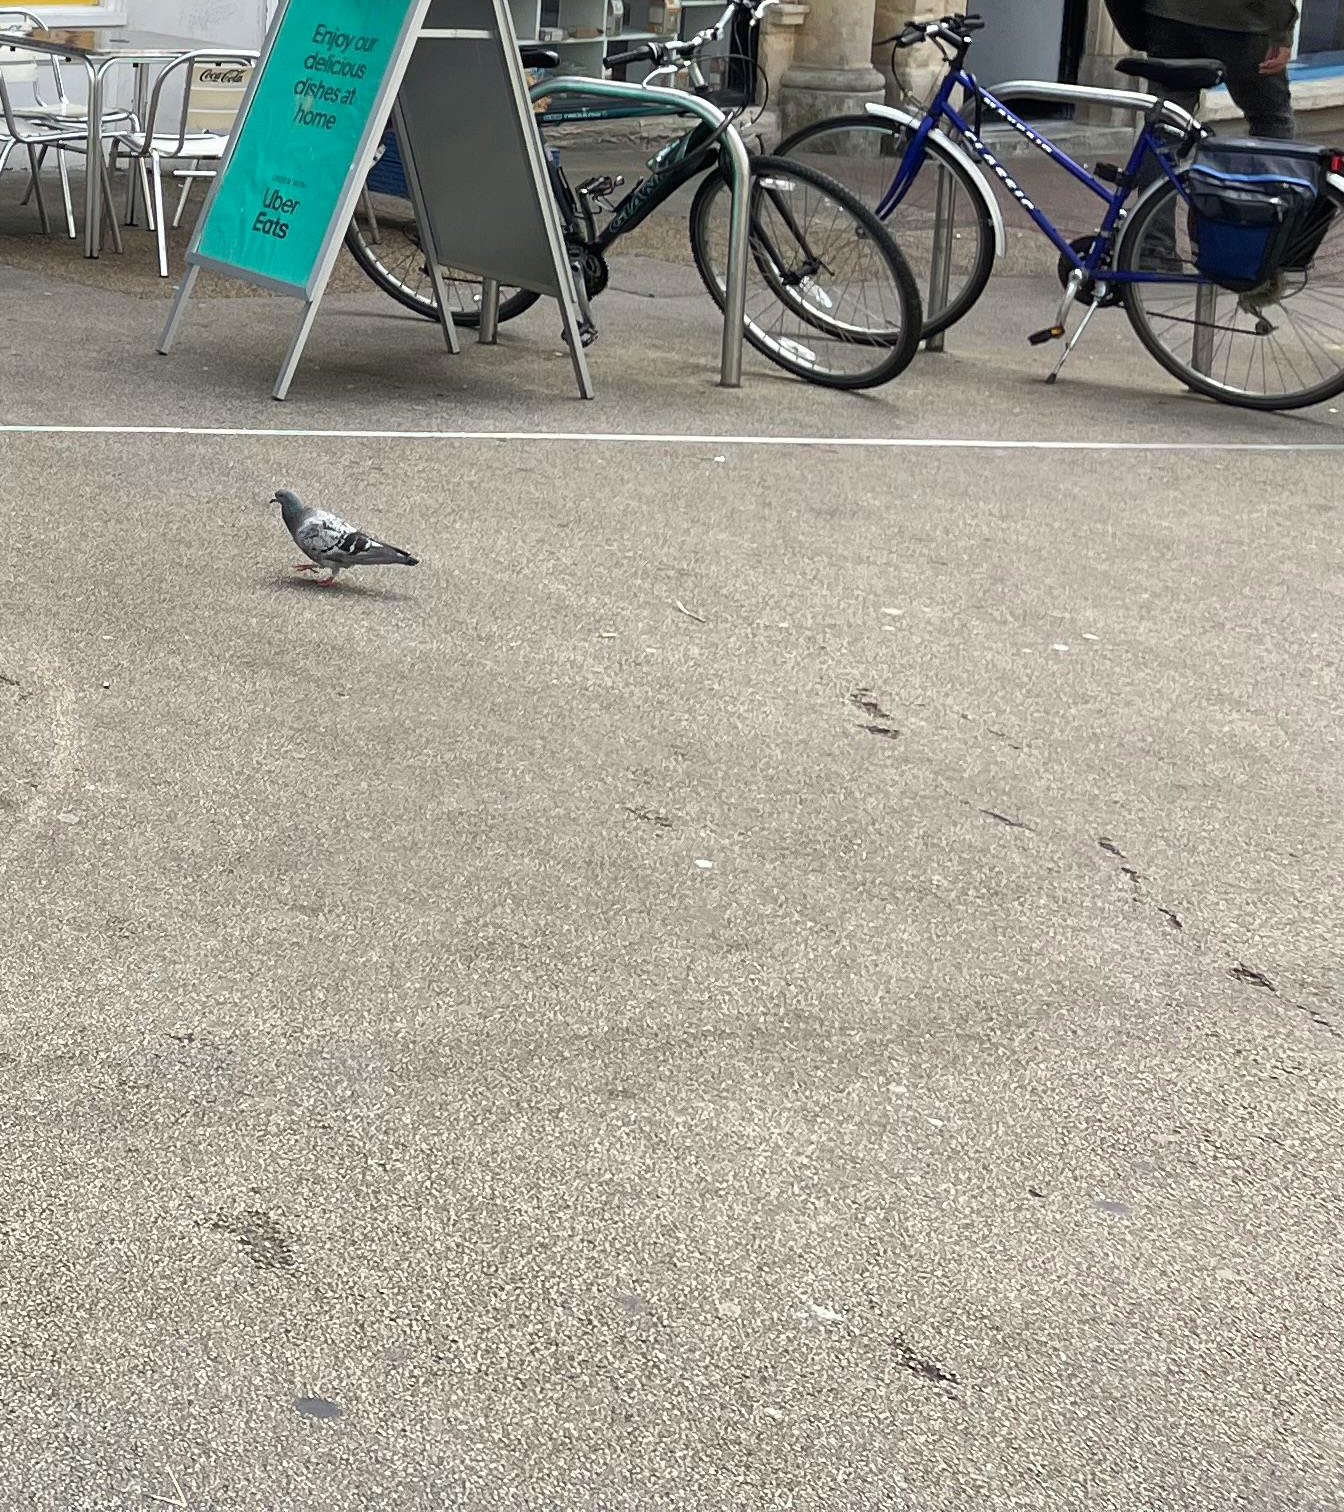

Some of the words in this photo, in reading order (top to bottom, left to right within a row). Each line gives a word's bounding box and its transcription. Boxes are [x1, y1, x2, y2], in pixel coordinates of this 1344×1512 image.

[312, 23, 353, 53] Enjoy
[354, 36, 379, 53] our
[303, 52, 368, 80] delicious
[293, 77, 339, 104] dishes
[339, 87, 357, 106] at
[293, 104, 337, 131] home
[262, 186, 301, 216] Uber
[251, 211, 290, 240] Eats
